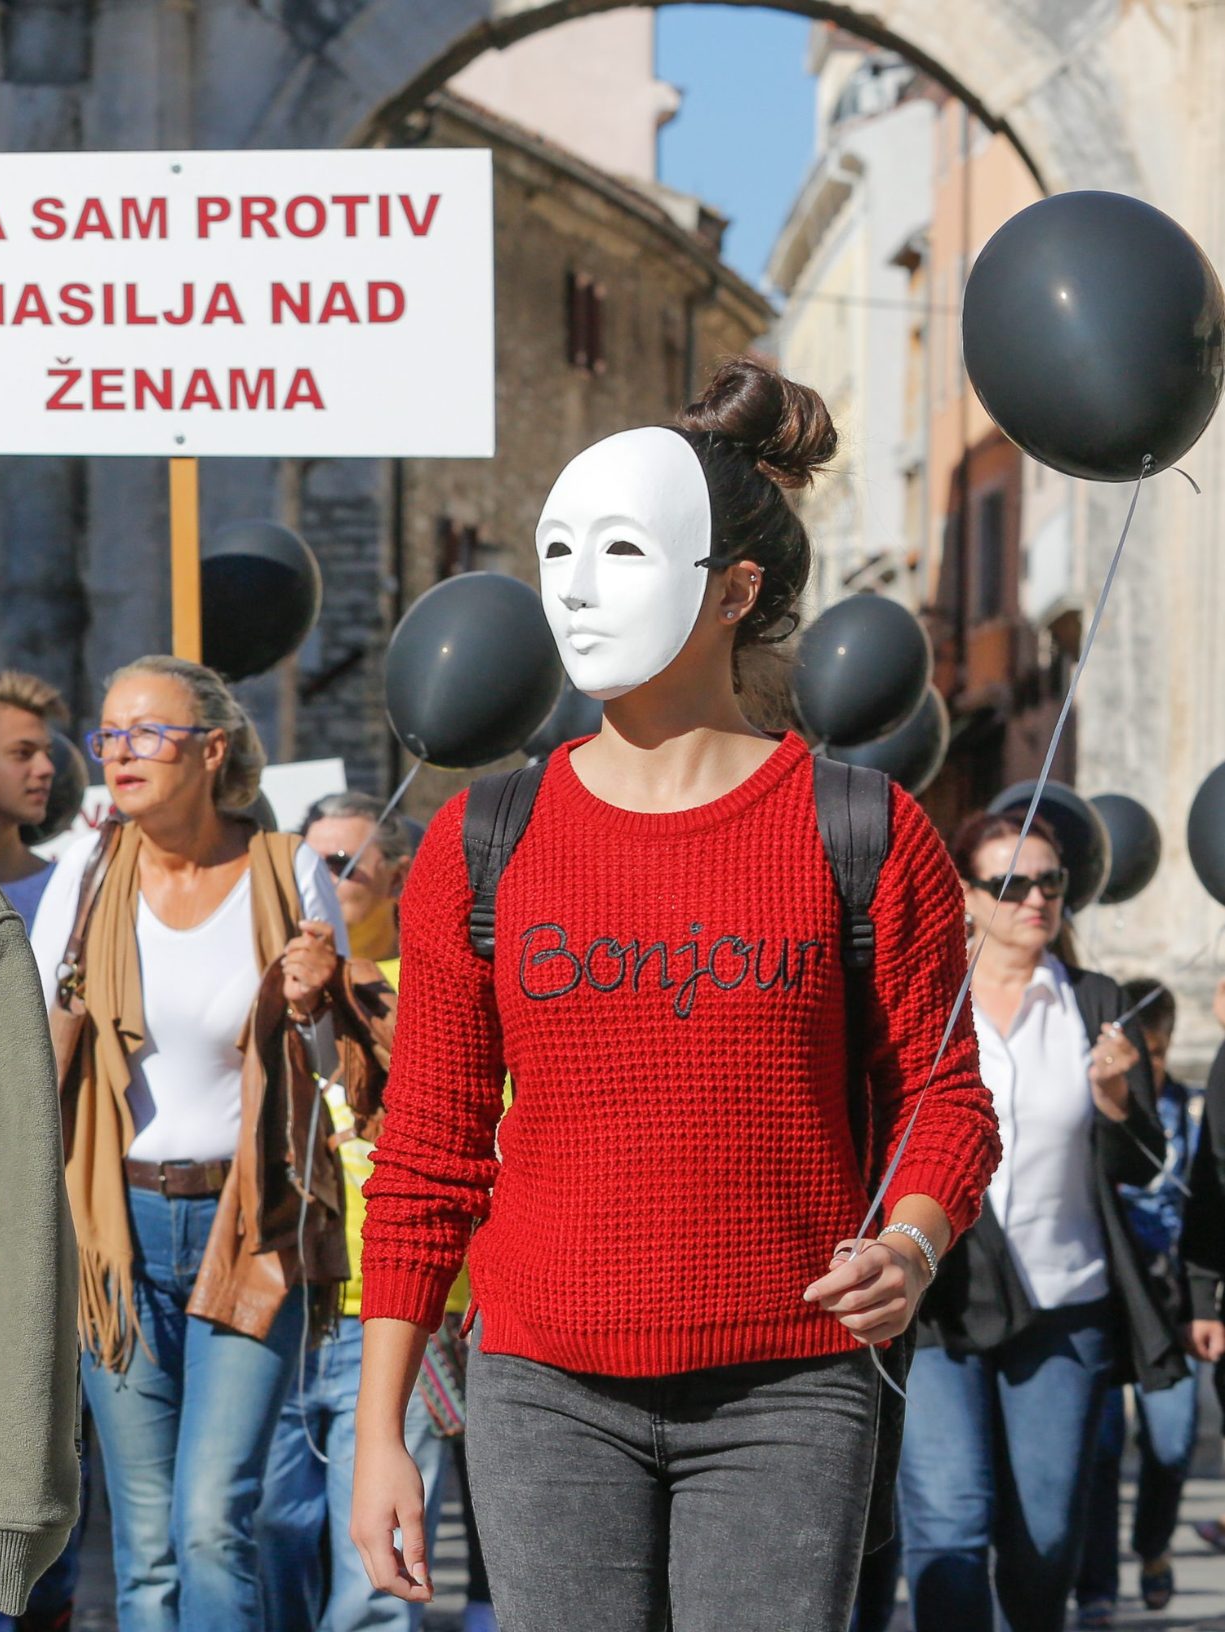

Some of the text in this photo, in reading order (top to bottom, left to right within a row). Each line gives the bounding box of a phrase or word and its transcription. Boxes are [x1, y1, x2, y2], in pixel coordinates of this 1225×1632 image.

[32, 197, 168, 240] SAM
[197, 194, 441, 239] PROTIV
[272, 280, 406, 324] NAD
[46, 357, 326, 411] ŽENAMA
[519, 921, 824, 1019] Bonjour
